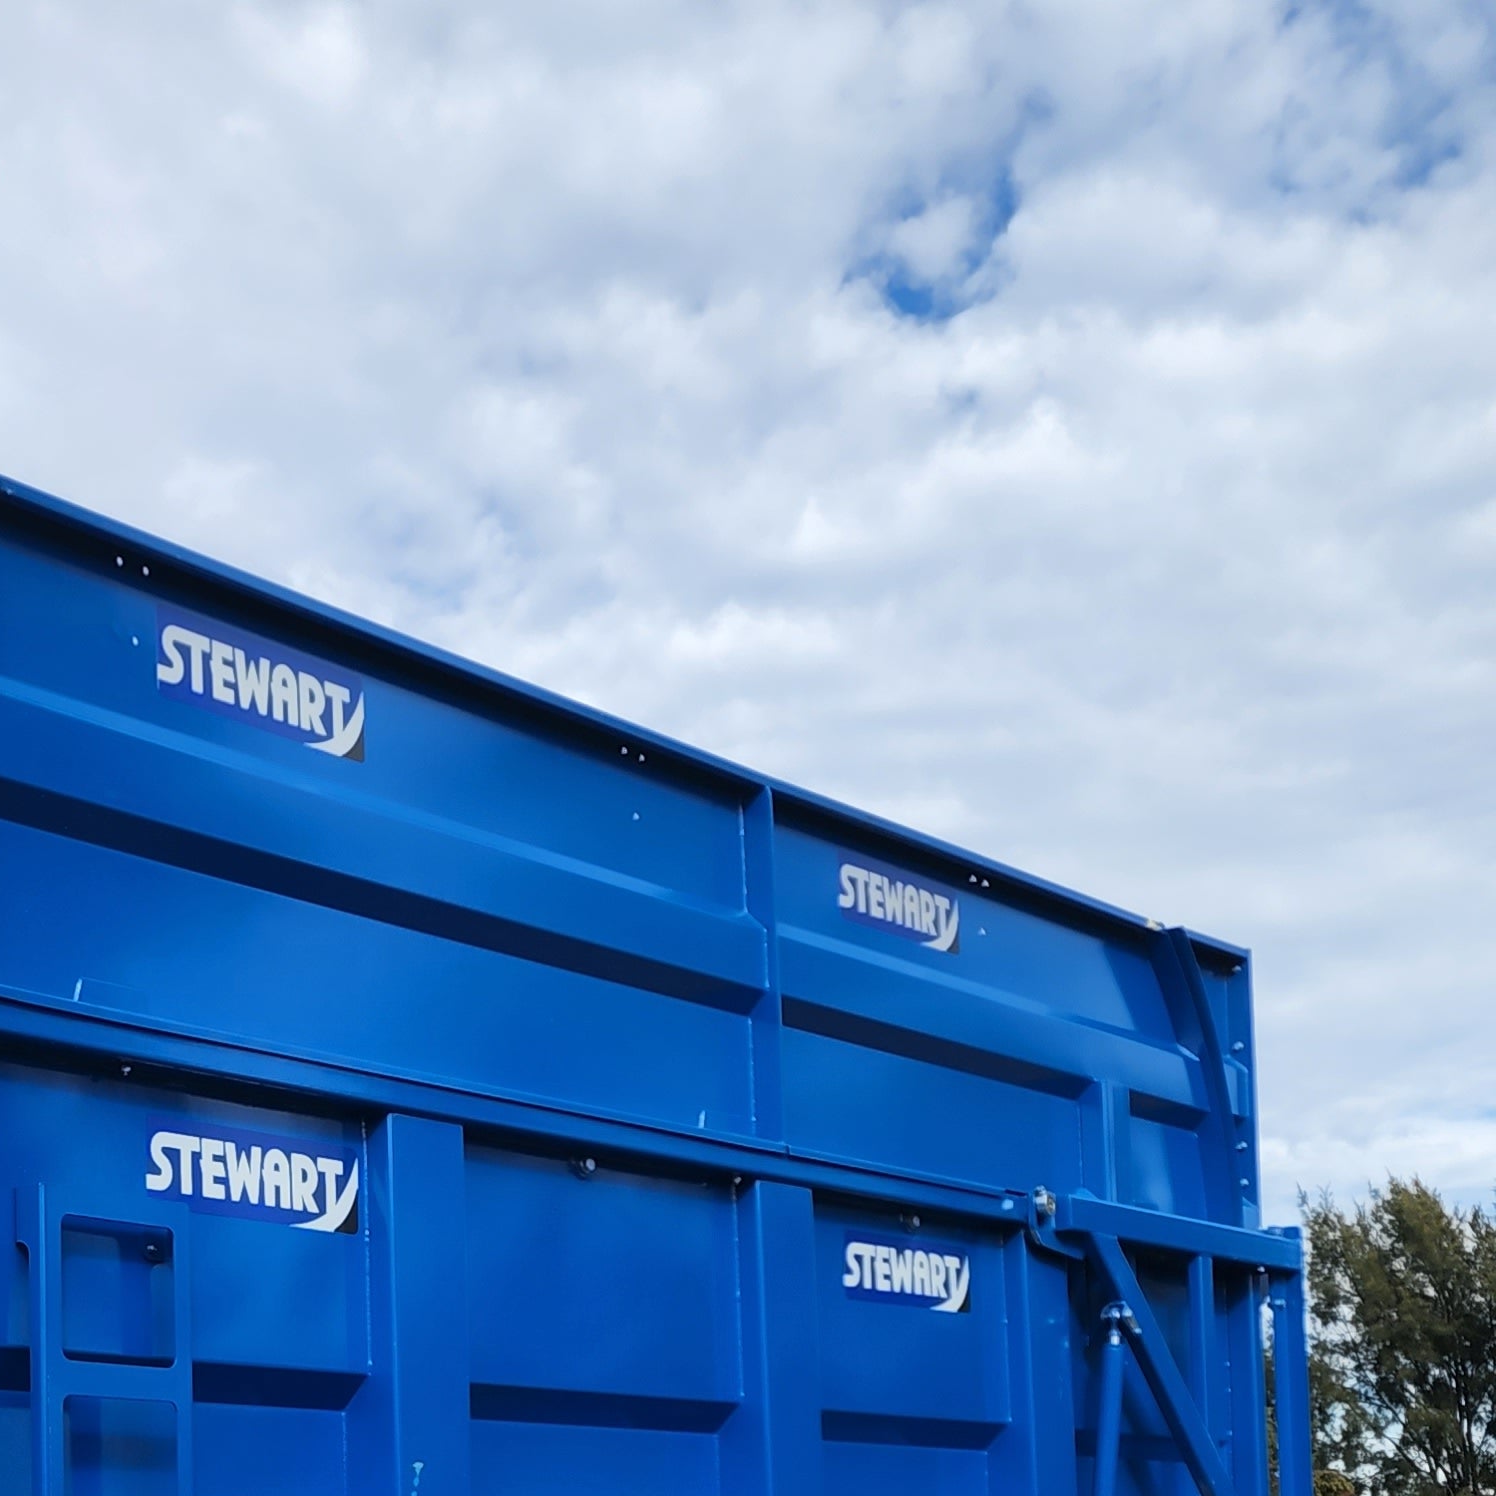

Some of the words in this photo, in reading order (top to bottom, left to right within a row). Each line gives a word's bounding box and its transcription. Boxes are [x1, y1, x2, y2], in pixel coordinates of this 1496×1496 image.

[157, 625, 364, 757] STEWART
[838, 864, 959, 951] STEWART
[146, 1131, 359, 1233] STEWART
[842, 1242, 970, 1312] STEWART
